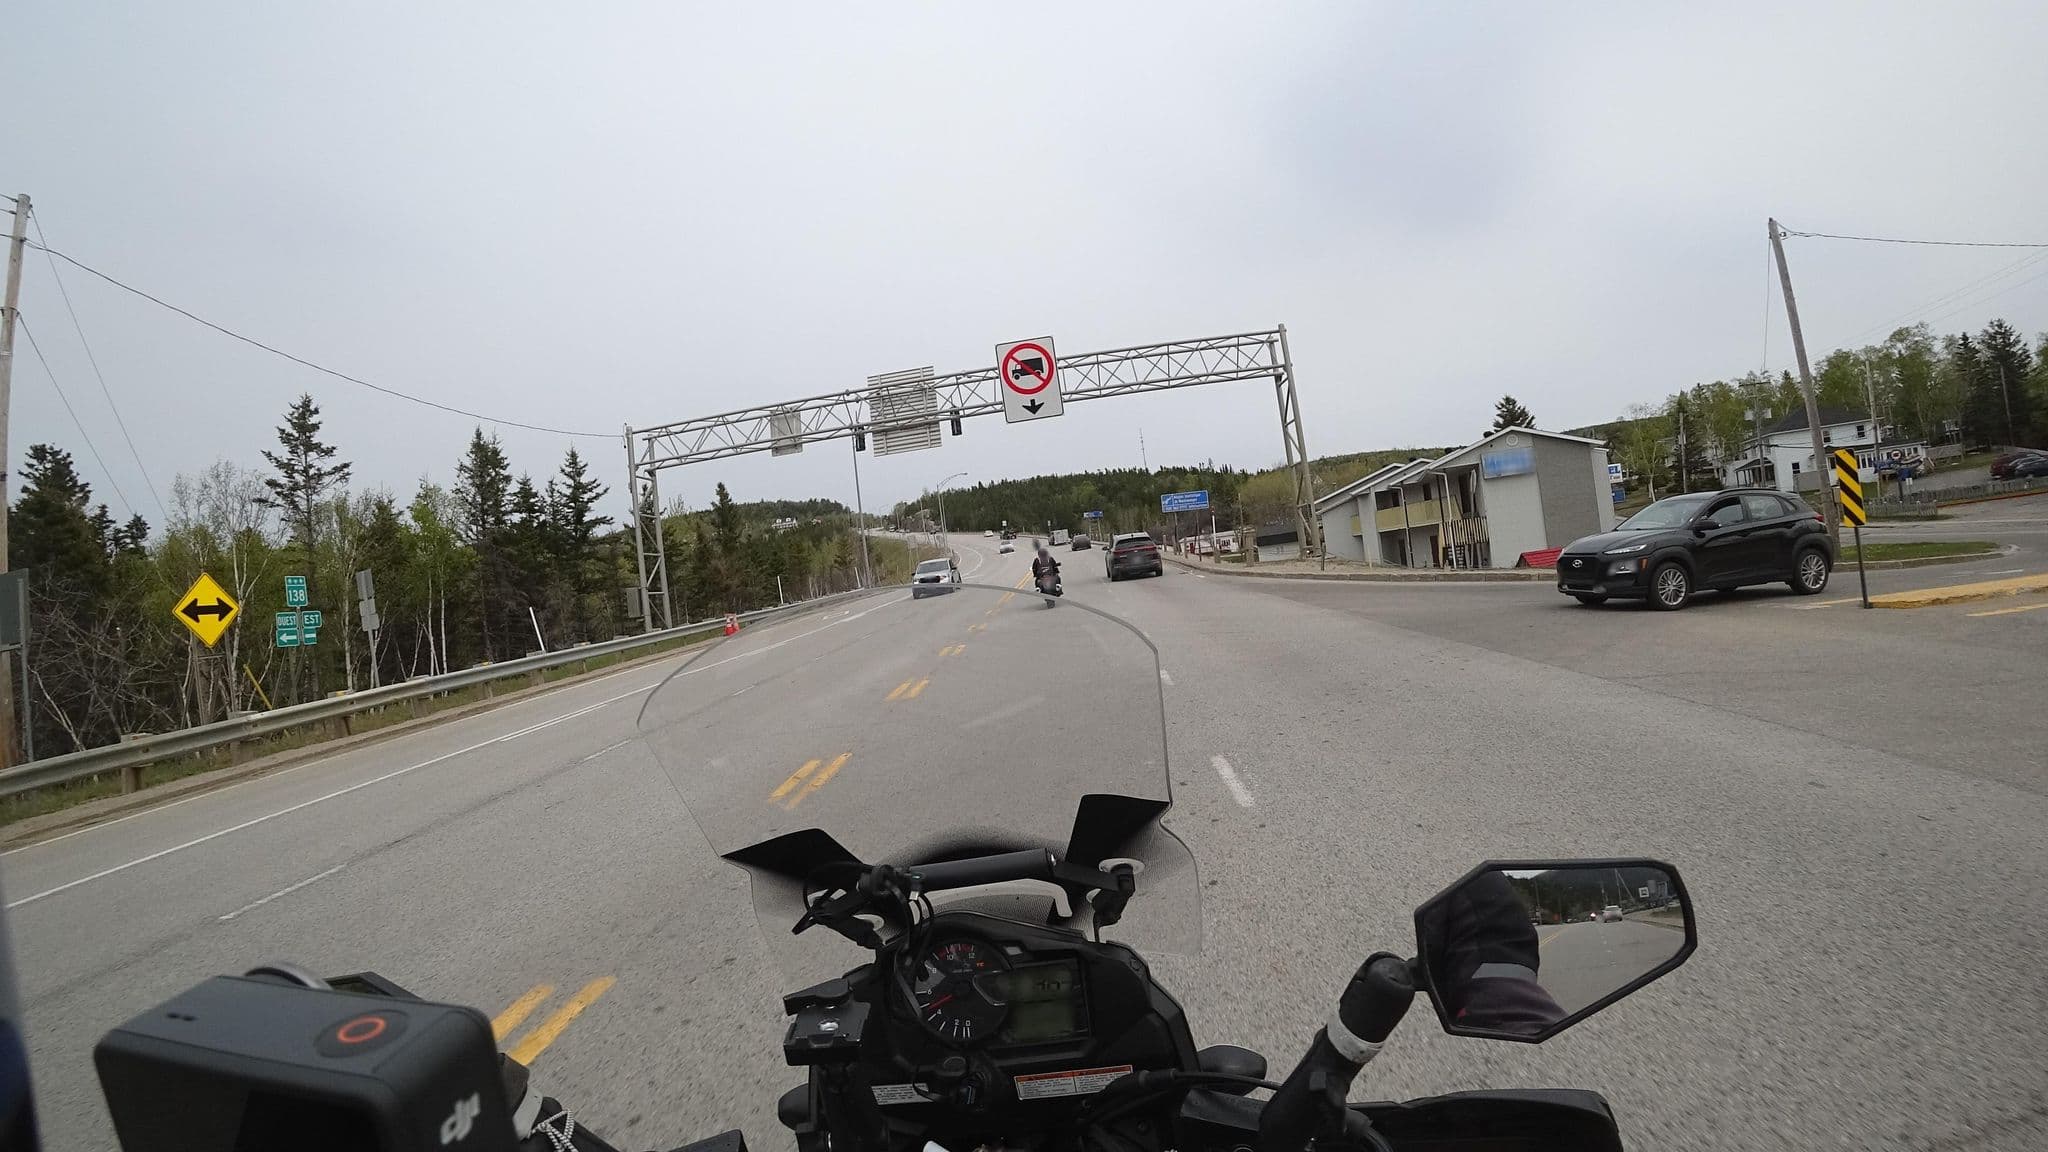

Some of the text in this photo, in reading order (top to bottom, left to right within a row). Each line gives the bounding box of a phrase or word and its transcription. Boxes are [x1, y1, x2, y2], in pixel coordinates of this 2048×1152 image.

[288, 589, 305, 602] 138
[278, 616, 296, 626] OUEST
[304, 614, 319, 624] EST
